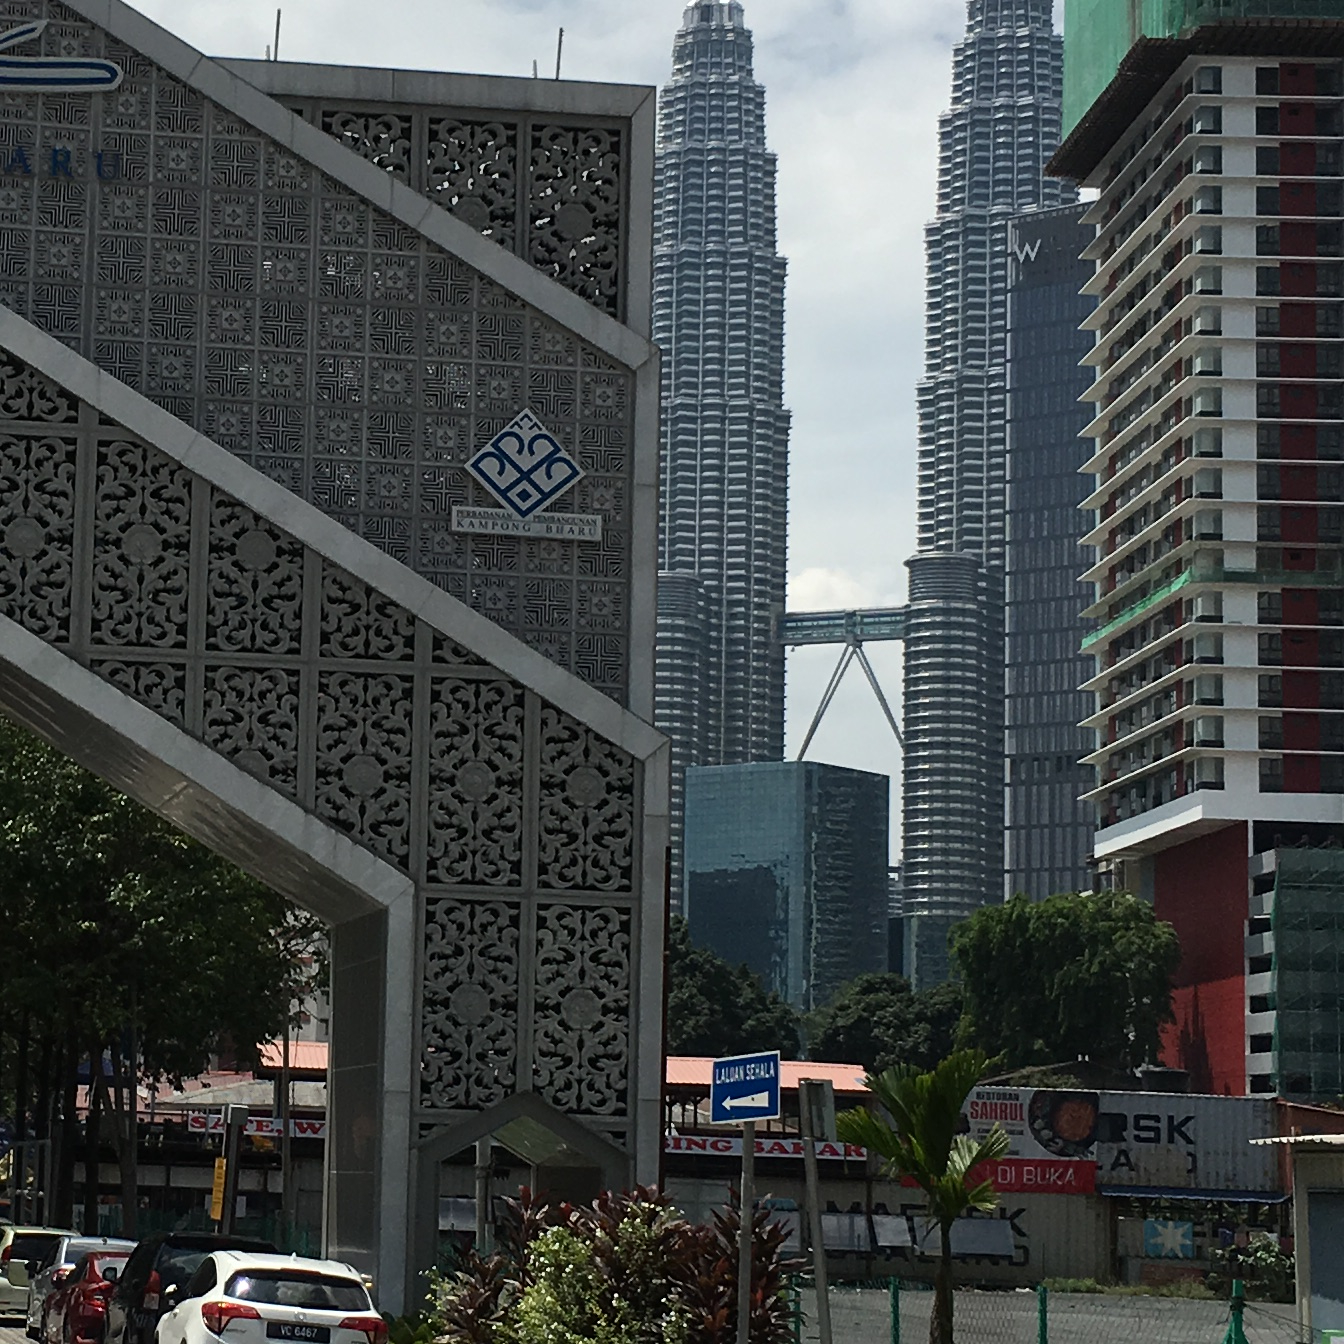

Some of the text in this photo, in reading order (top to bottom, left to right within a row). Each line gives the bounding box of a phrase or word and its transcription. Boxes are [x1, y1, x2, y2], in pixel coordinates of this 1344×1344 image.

[456, 509, 597, 526] PERBADANAN PEMBANGUNAN
[456, 519, 597, 537] KAMPONG BHARU
[715, 1061, 775, 1085] LALUAN SEHALA
[969, 1100, 1025, 1122] SAHRUL
[997, 1165, 1016, 1185] DI
[1023, 1166, 1076, 1187] BUKA
[280, 1325, 318, 1338] VC 6467
